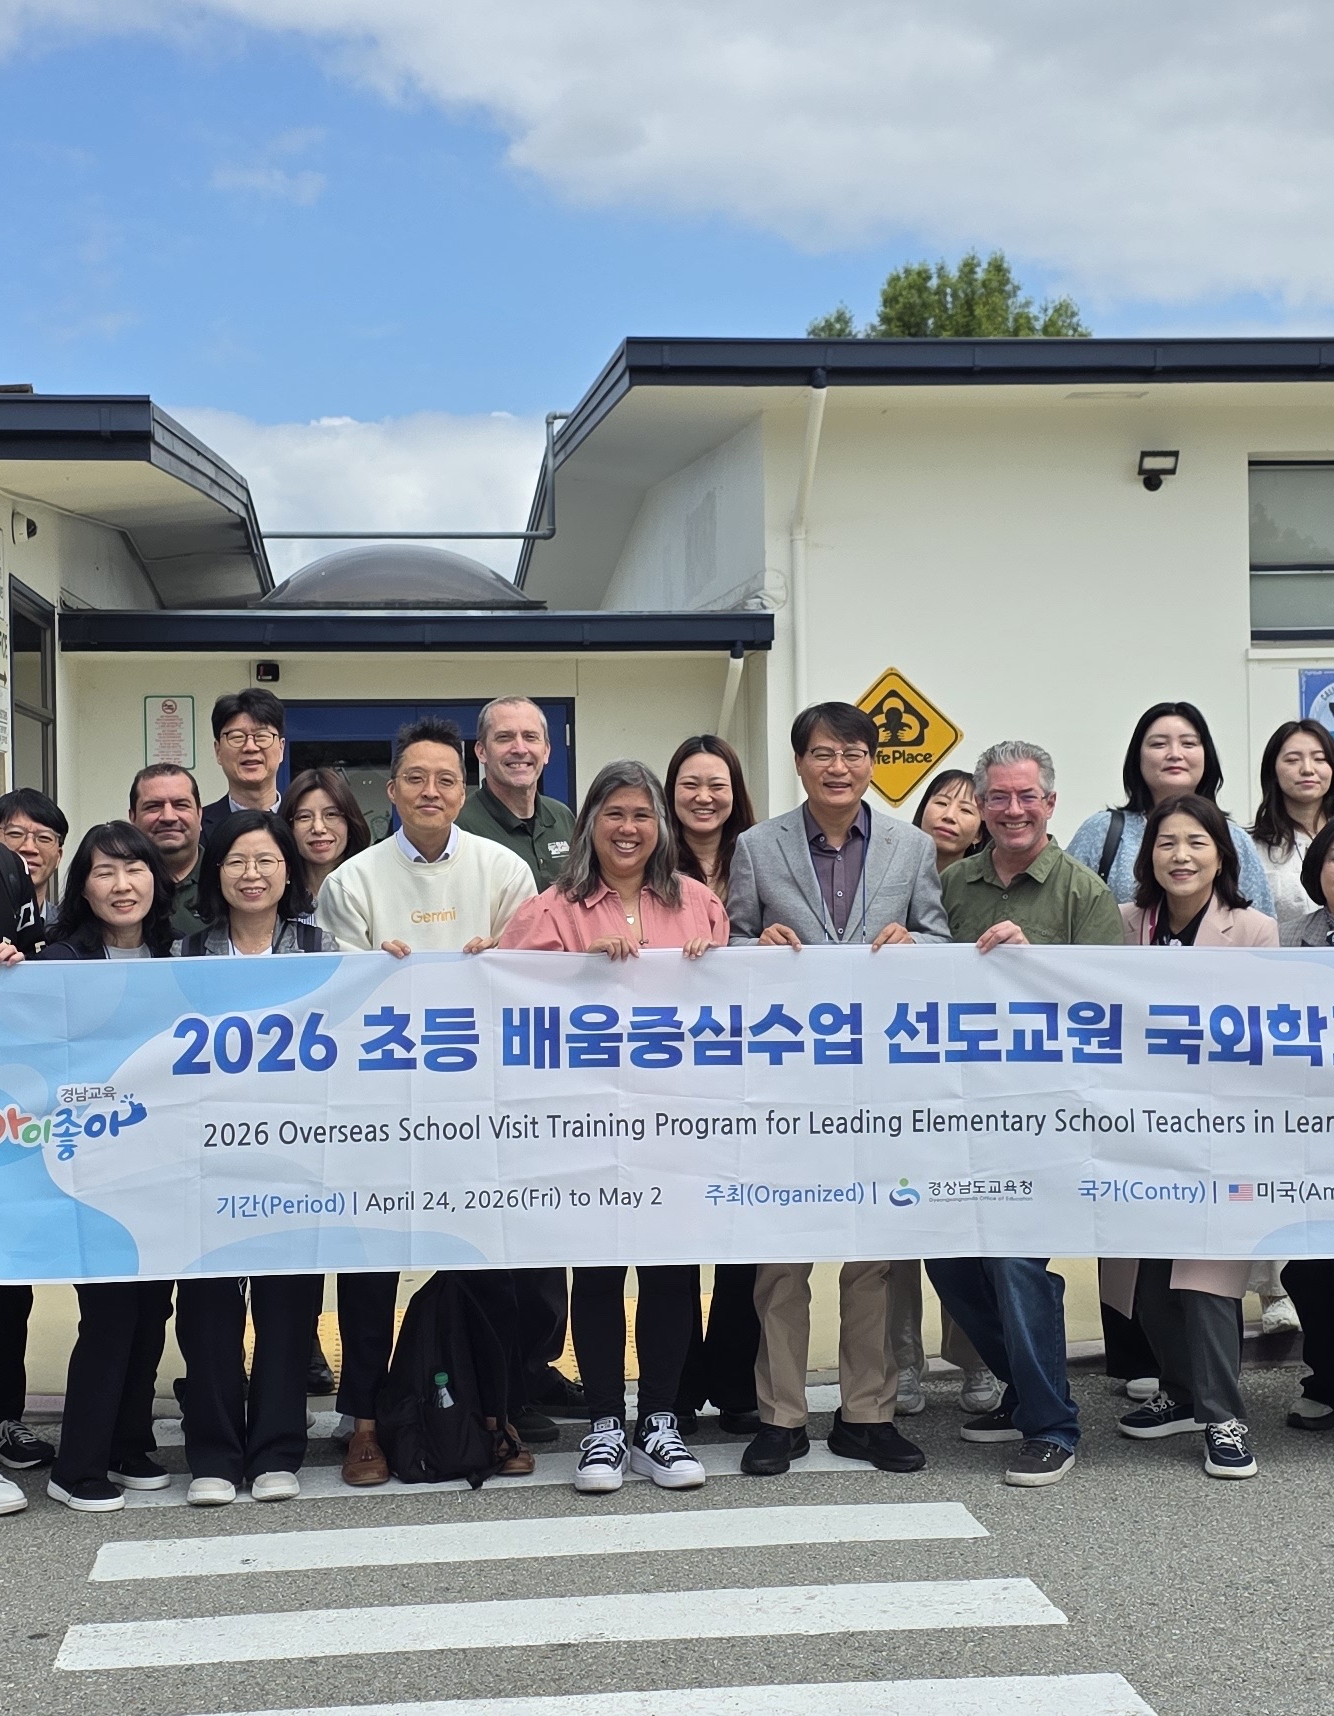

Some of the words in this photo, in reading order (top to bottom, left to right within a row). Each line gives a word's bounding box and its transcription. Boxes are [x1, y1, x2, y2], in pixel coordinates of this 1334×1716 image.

[892, 750, 933, 764] Place
[411, 907, 457, 924] Gemini
[172, 1012, 338, 1076] 2026
[358, 1005, 480, 1073] 초등
[502, 1002, 863, 1069] 배움중심수업
[883, 1001, 1123, 1065] 선도교원
[60, 1086, 117, 1103] 경남교육
[204, 1122, 269, 1148] 2026
[278, 1120, 390, 1145] Overseas
[398, 1115, 481, 1142] School
[487, 1114, 540, 1140] Visit
[545, 1113, 645, 1141] Training
[655, 1112, 757, 1140] Program
[765, 1109, 802, 1135] for
[809, 1109, 902, 1138] Leading
[912, 1107, 1047, 1137] Elementary
[1054, 1107, 1135, 1134] School
[1142, 1107, 1246, 1134] Teachers
[1254, 1108, 1275, 1134] in
[705, 1181, 865, 1208] 주최(Organized)
[928, 1179, 1033, 1196] 경상남도교육청
[1077, 1180, 1206, 1204] 국가(Contry)
[216, 1192, 346, 1219] 기간(Period)
[365, 1190, 415, 1214] April
[422, 1190, 457, 1214] 24,
[464, 1187, 561, 1213] 2026(Fri)
[569, 1188, 591, 1208] to
[598, 1187, 644, 1210] May
[650, 1187, 663, 1206] 2
